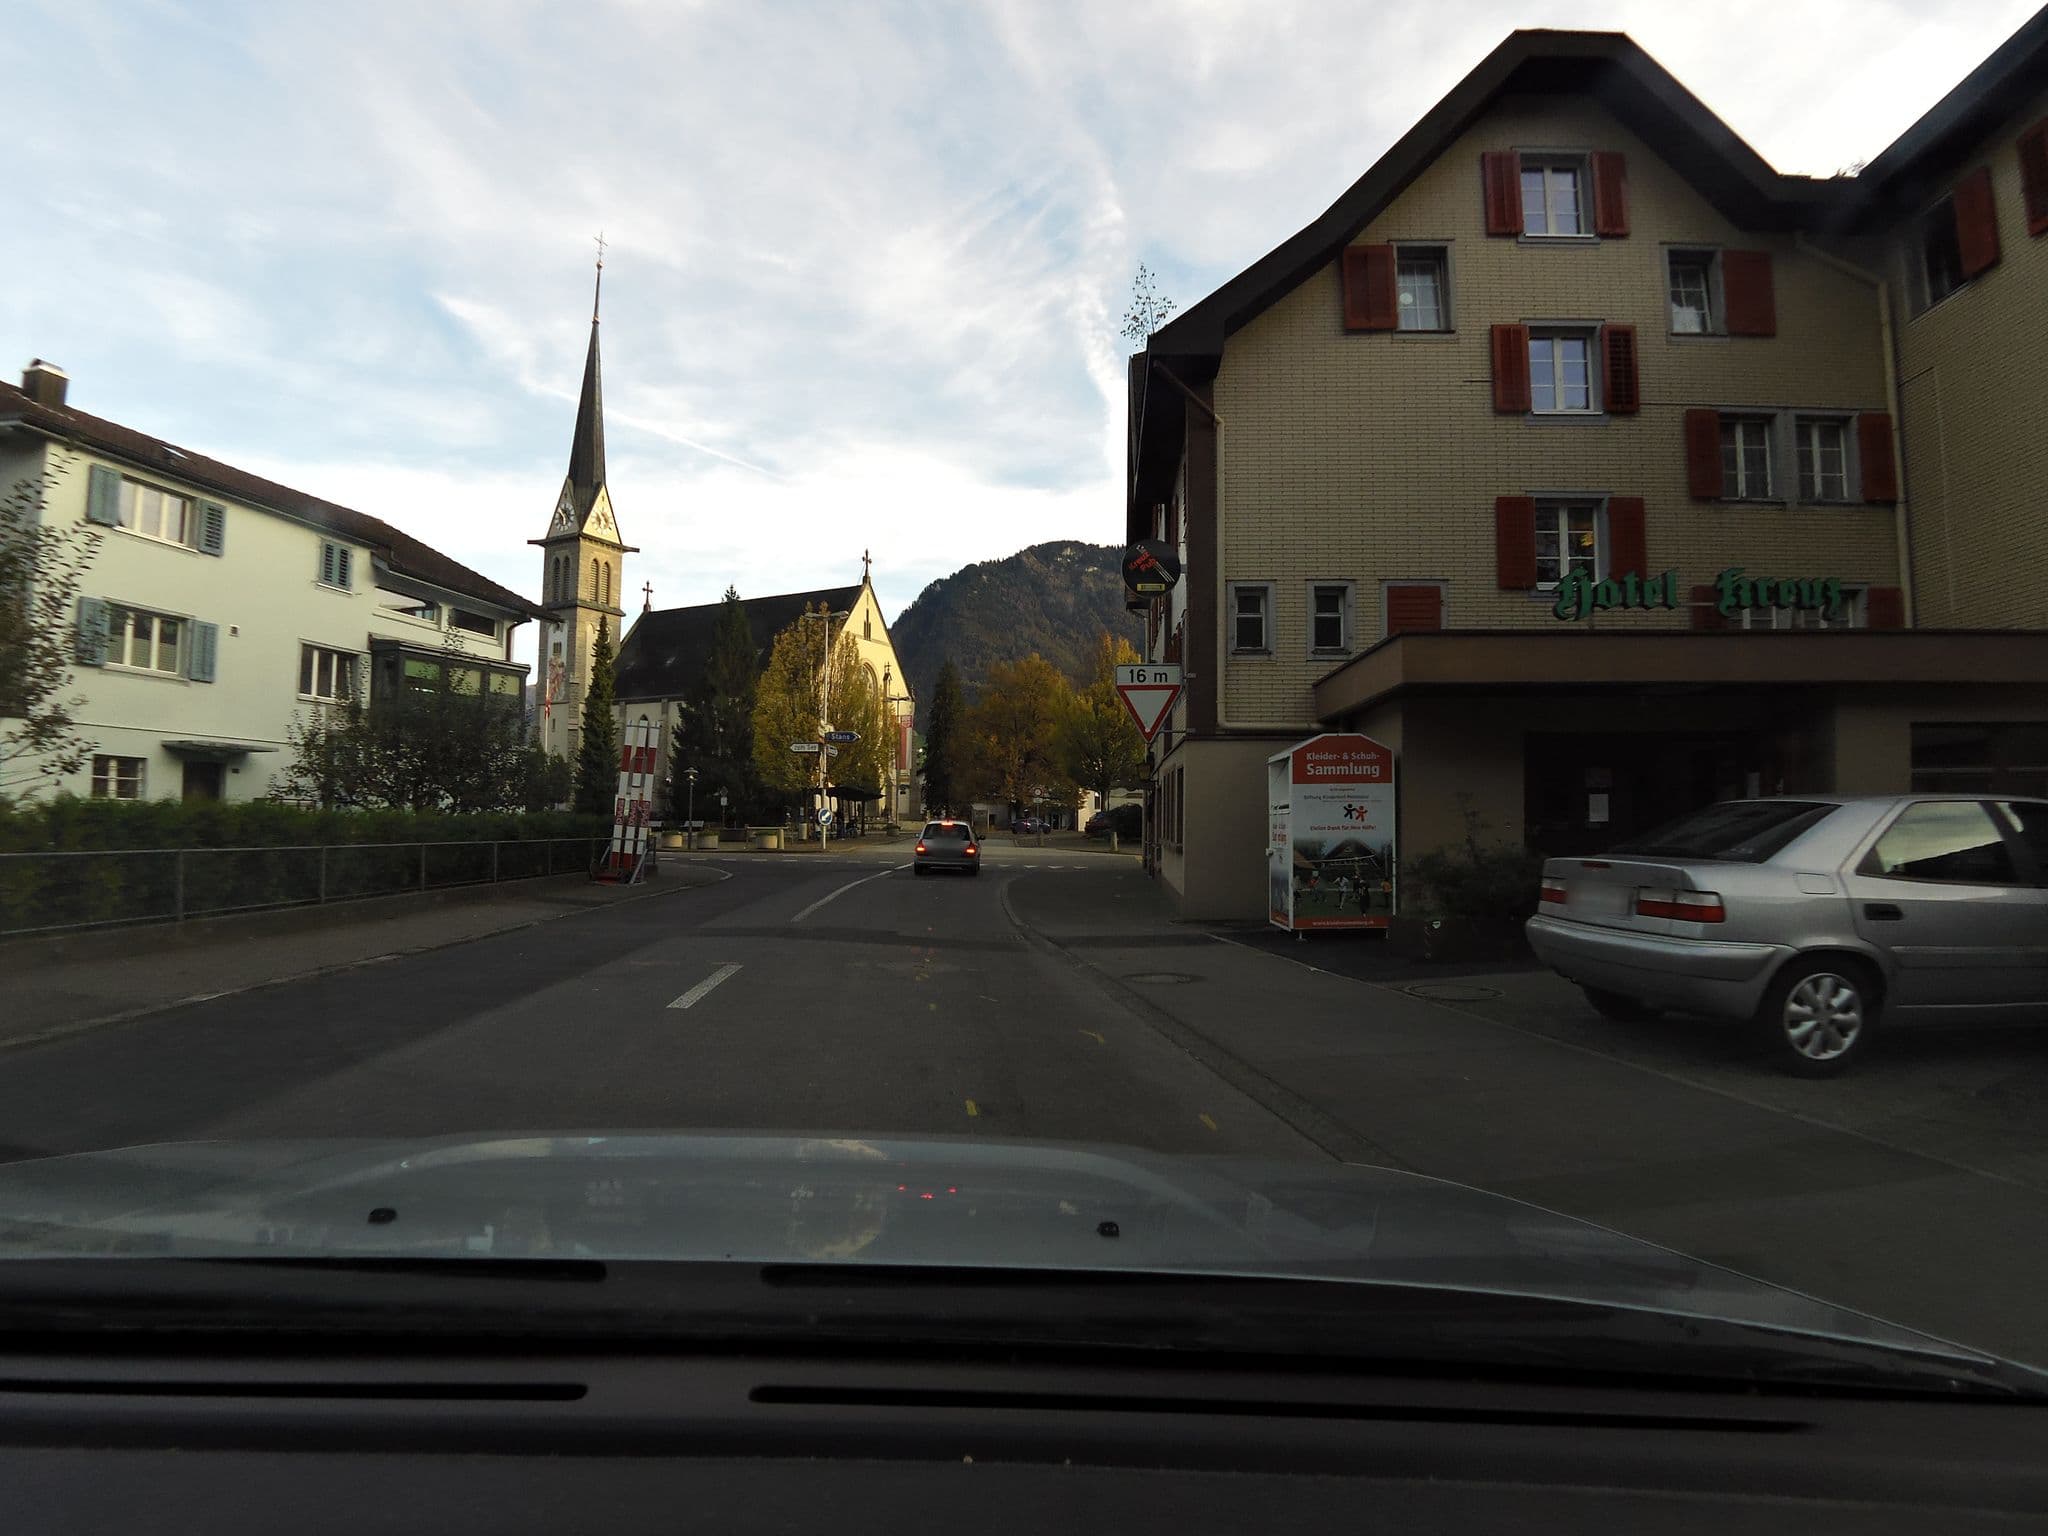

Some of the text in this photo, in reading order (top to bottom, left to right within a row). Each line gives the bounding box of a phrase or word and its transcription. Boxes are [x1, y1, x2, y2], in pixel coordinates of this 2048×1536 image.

[1552, 563, 1842, 621] Hotel Kreuz
[1129, 669, 1168, 683] 16 m
[1306, 752, 1380, 760] Kleider- & Schuh-
[1306, 762, 1380, 777] Sammlung
